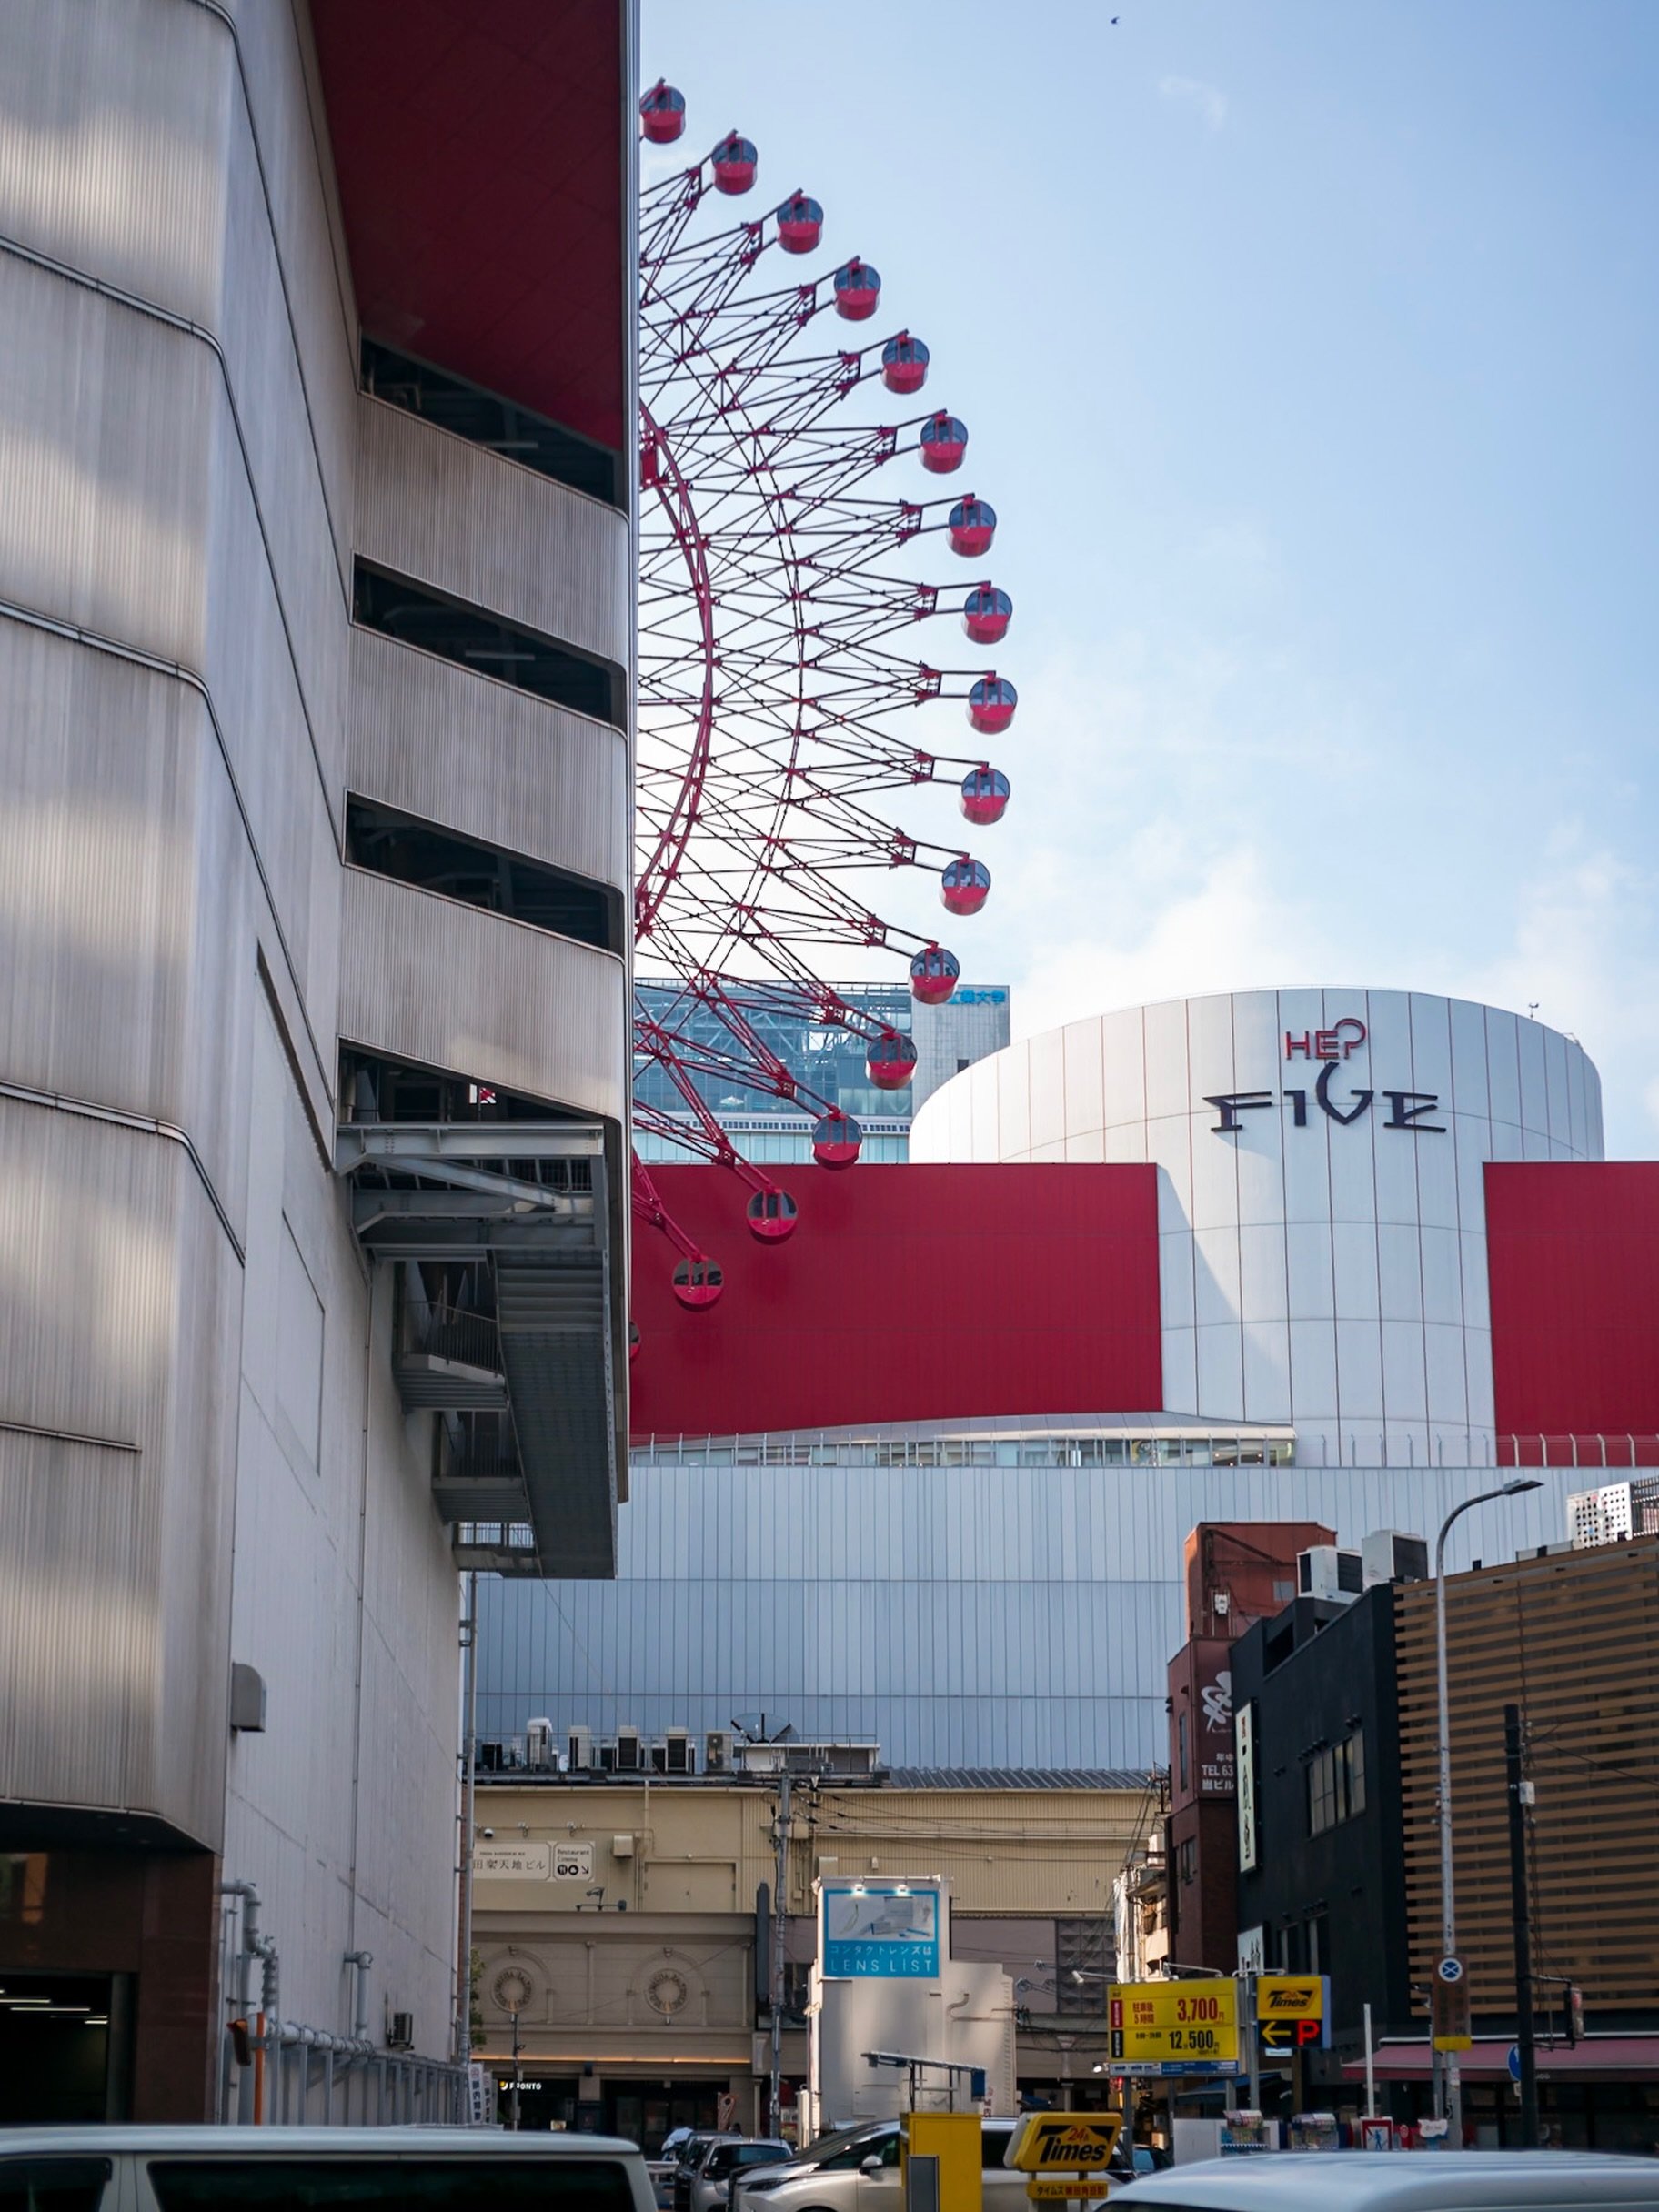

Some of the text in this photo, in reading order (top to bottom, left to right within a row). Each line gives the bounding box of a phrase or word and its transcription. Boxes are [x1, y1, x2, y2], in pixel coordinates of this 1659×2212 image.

[1285, 1018, 1366, 1060] HEP
[1202, 1061, 1446, 1132] FIVE
[1202, 1765, 1220, 1776] TEL
[831, 1945, 932, 1955] コンタクトレンズは
[830, 1959, 932, 1972] LENS LIST
[1269, 1990, 1310, 2008] Times
[1297, 2021, 1320, 2046] P
[1038, 2133, 1107, 2163] Times
